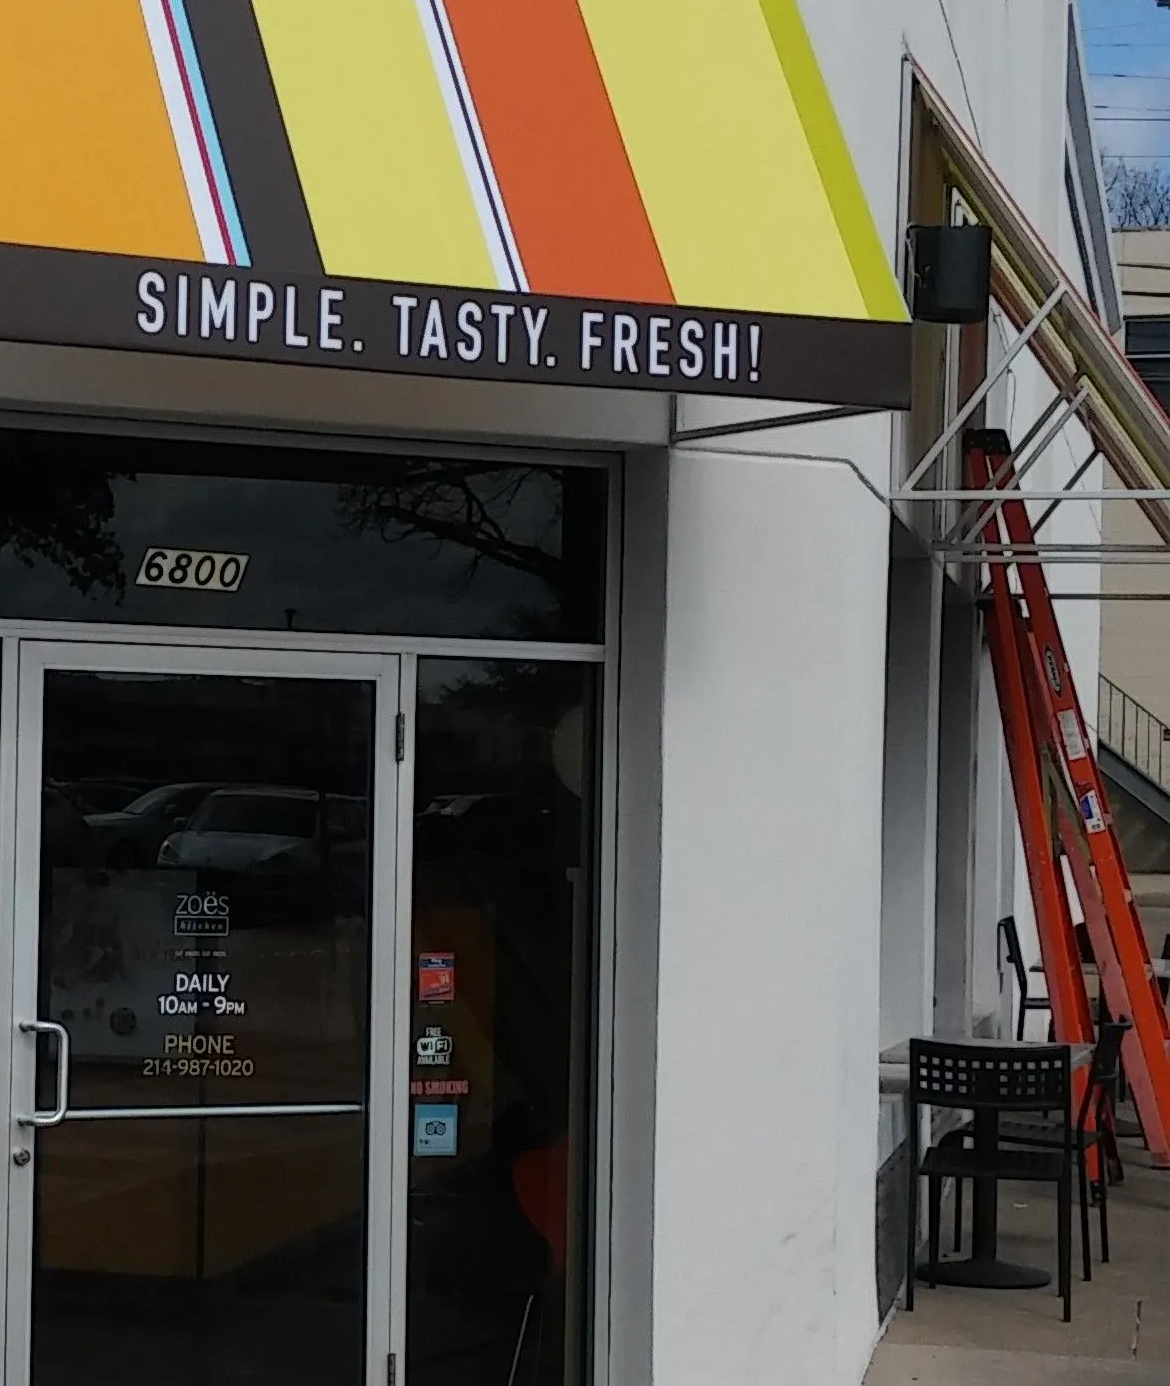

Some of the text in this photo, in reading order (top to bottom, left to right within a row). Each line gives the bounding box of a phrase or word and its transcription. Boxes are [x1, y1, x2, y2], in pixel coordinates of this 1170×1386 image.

[135, 269, 763, 382] SIMPLE. TASTY. FRESH!
[142, 550, 241, 589] 6800
[175, 974, 230, 993] DAILY
[164, 1035, 235, 1054] PHONE
[142, 1059, 254, 1077] 214-987-1020
[424, 1080, 470, 1096] SMOKING
